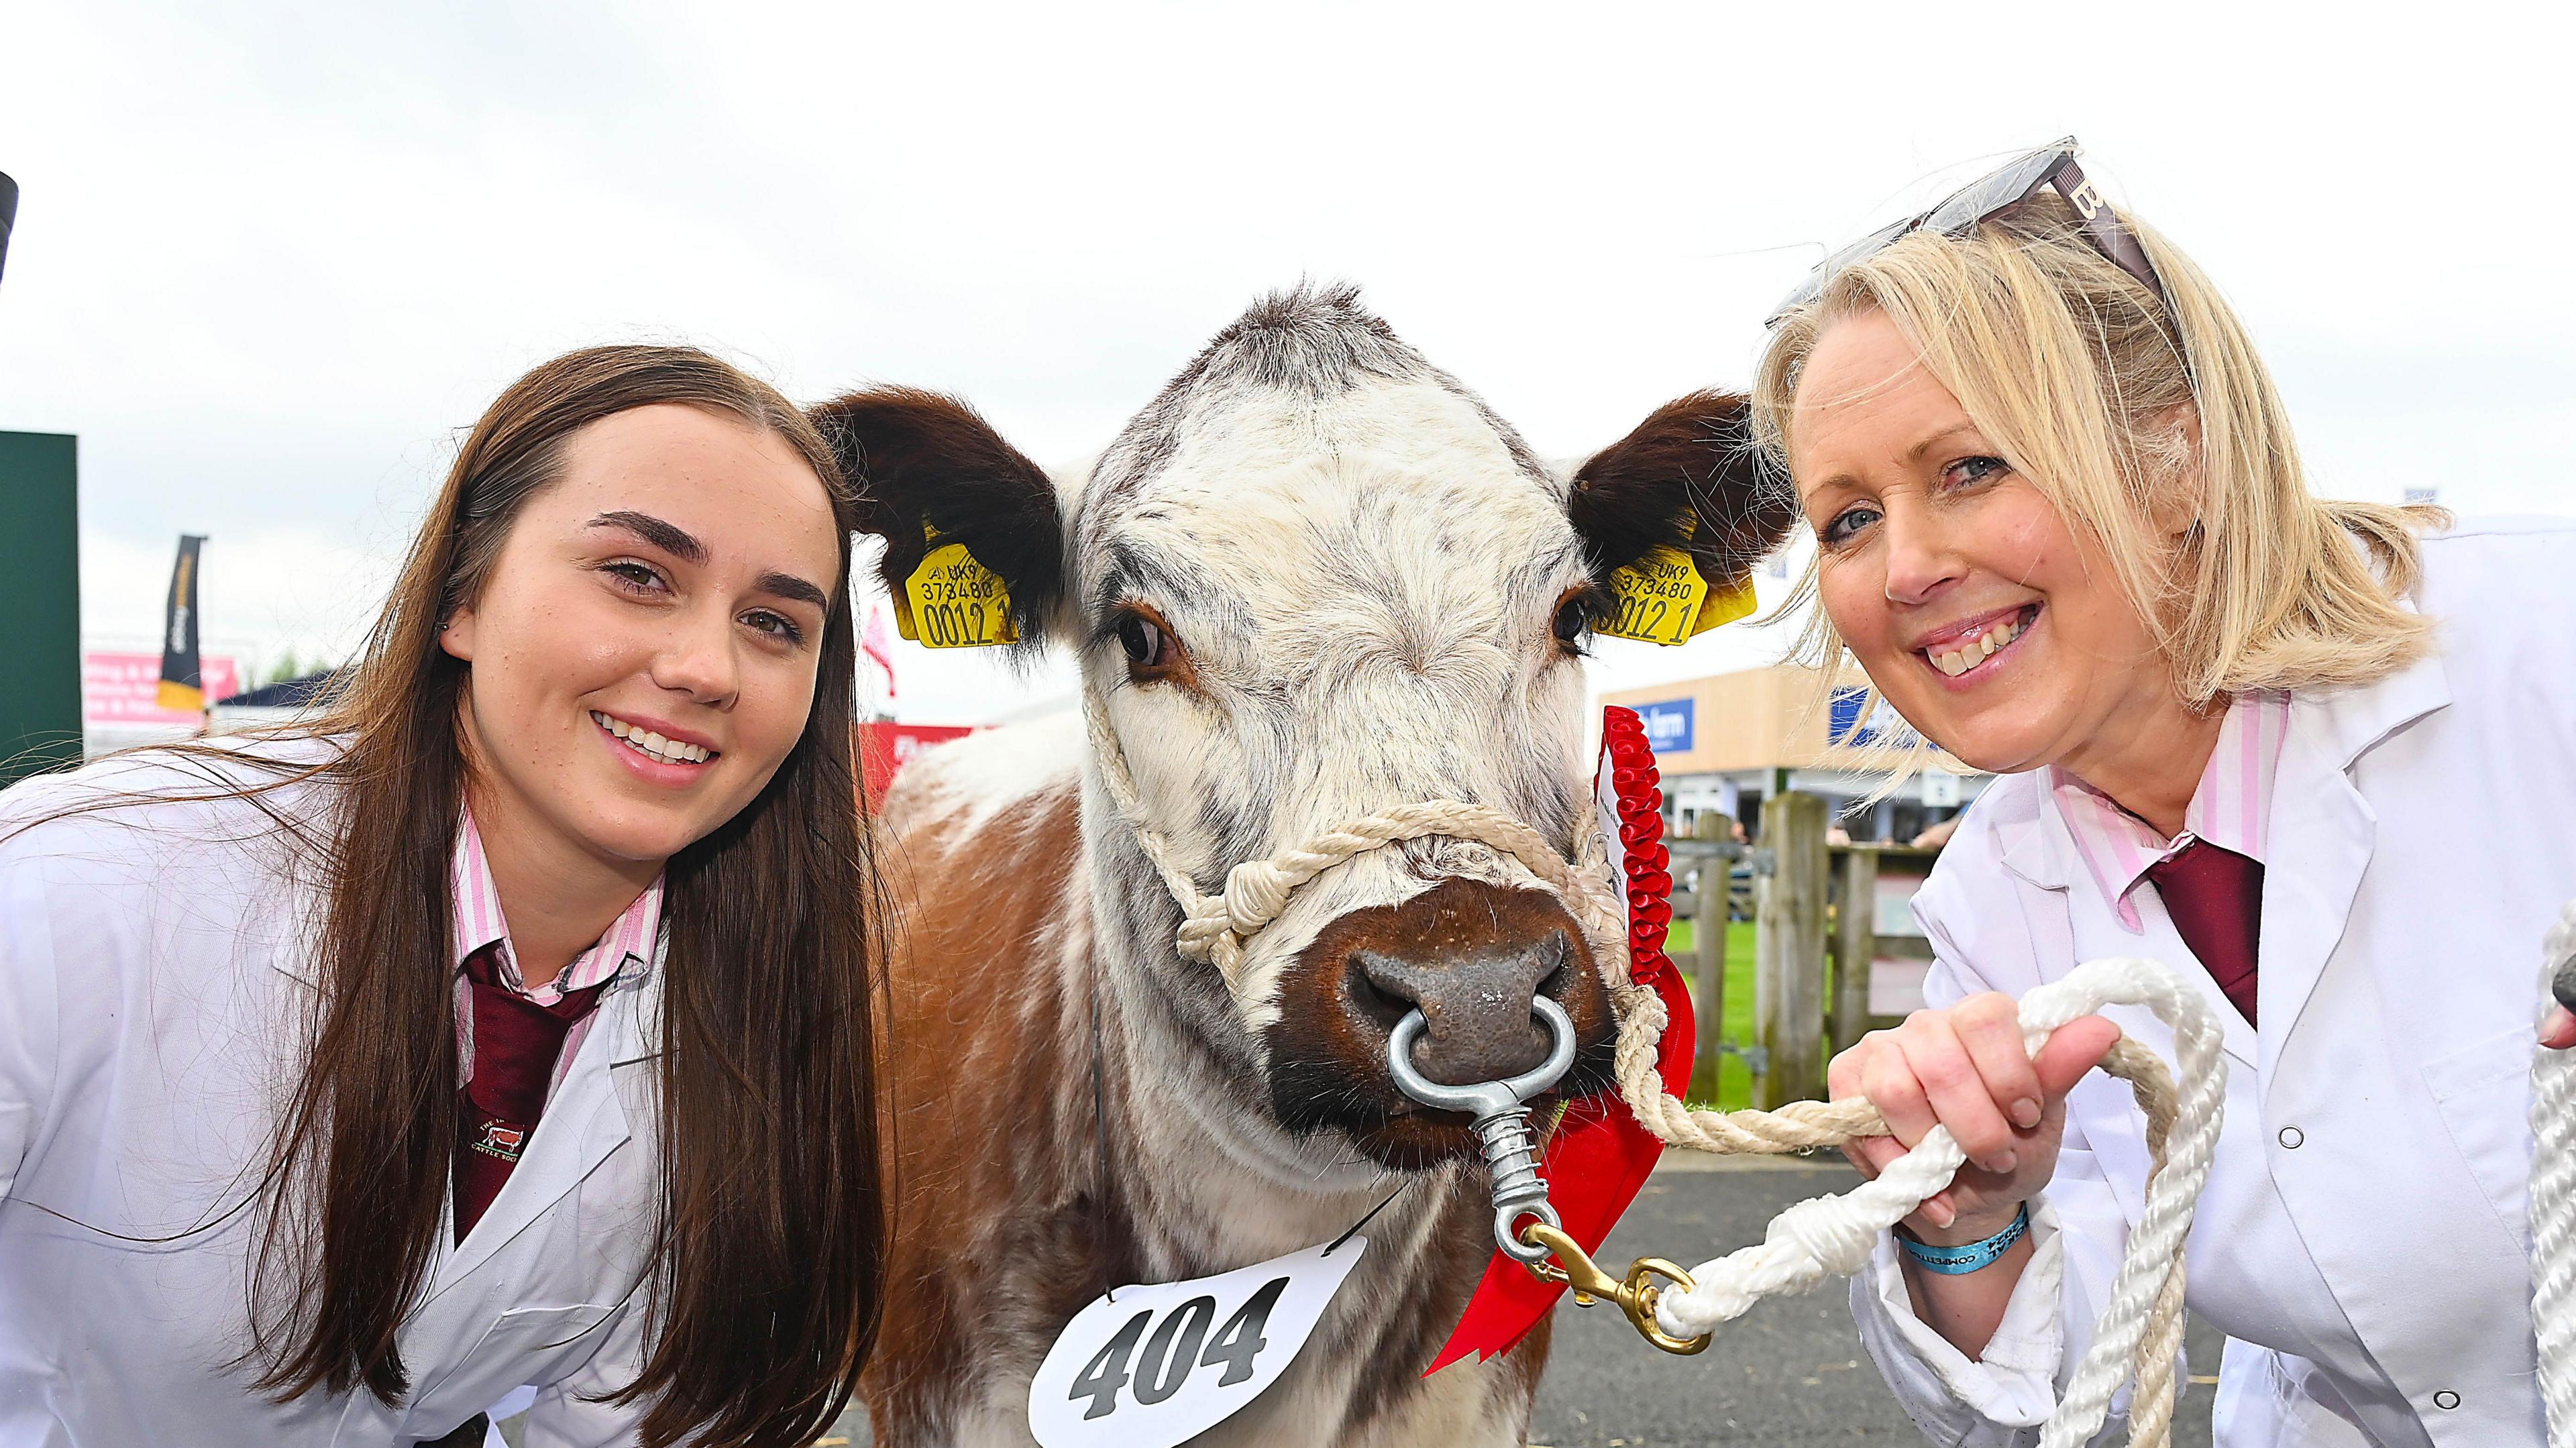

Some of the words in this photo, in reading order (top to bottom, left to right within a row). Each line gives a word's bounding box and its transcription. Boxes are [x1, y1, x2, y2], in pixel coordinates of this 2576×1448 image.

[2069, 177, 2104, 221] B
[947, 564, 977, 581] UK9
[1658, 563, 1689, 581] UK9
[921, 581, 994, 601] 373480
[1621, 575, 1692, 600] 373480
[924, 602, 993, 646] 0012
[1669, 602, 1693, 643] 1
[479, 1120, 494, 1132] THE
[471, 1144, 499, 1158] CATTLE
[1986, 1222, 2019, 1251] 2024
[1069, 1276, 1291, 1421] 404
